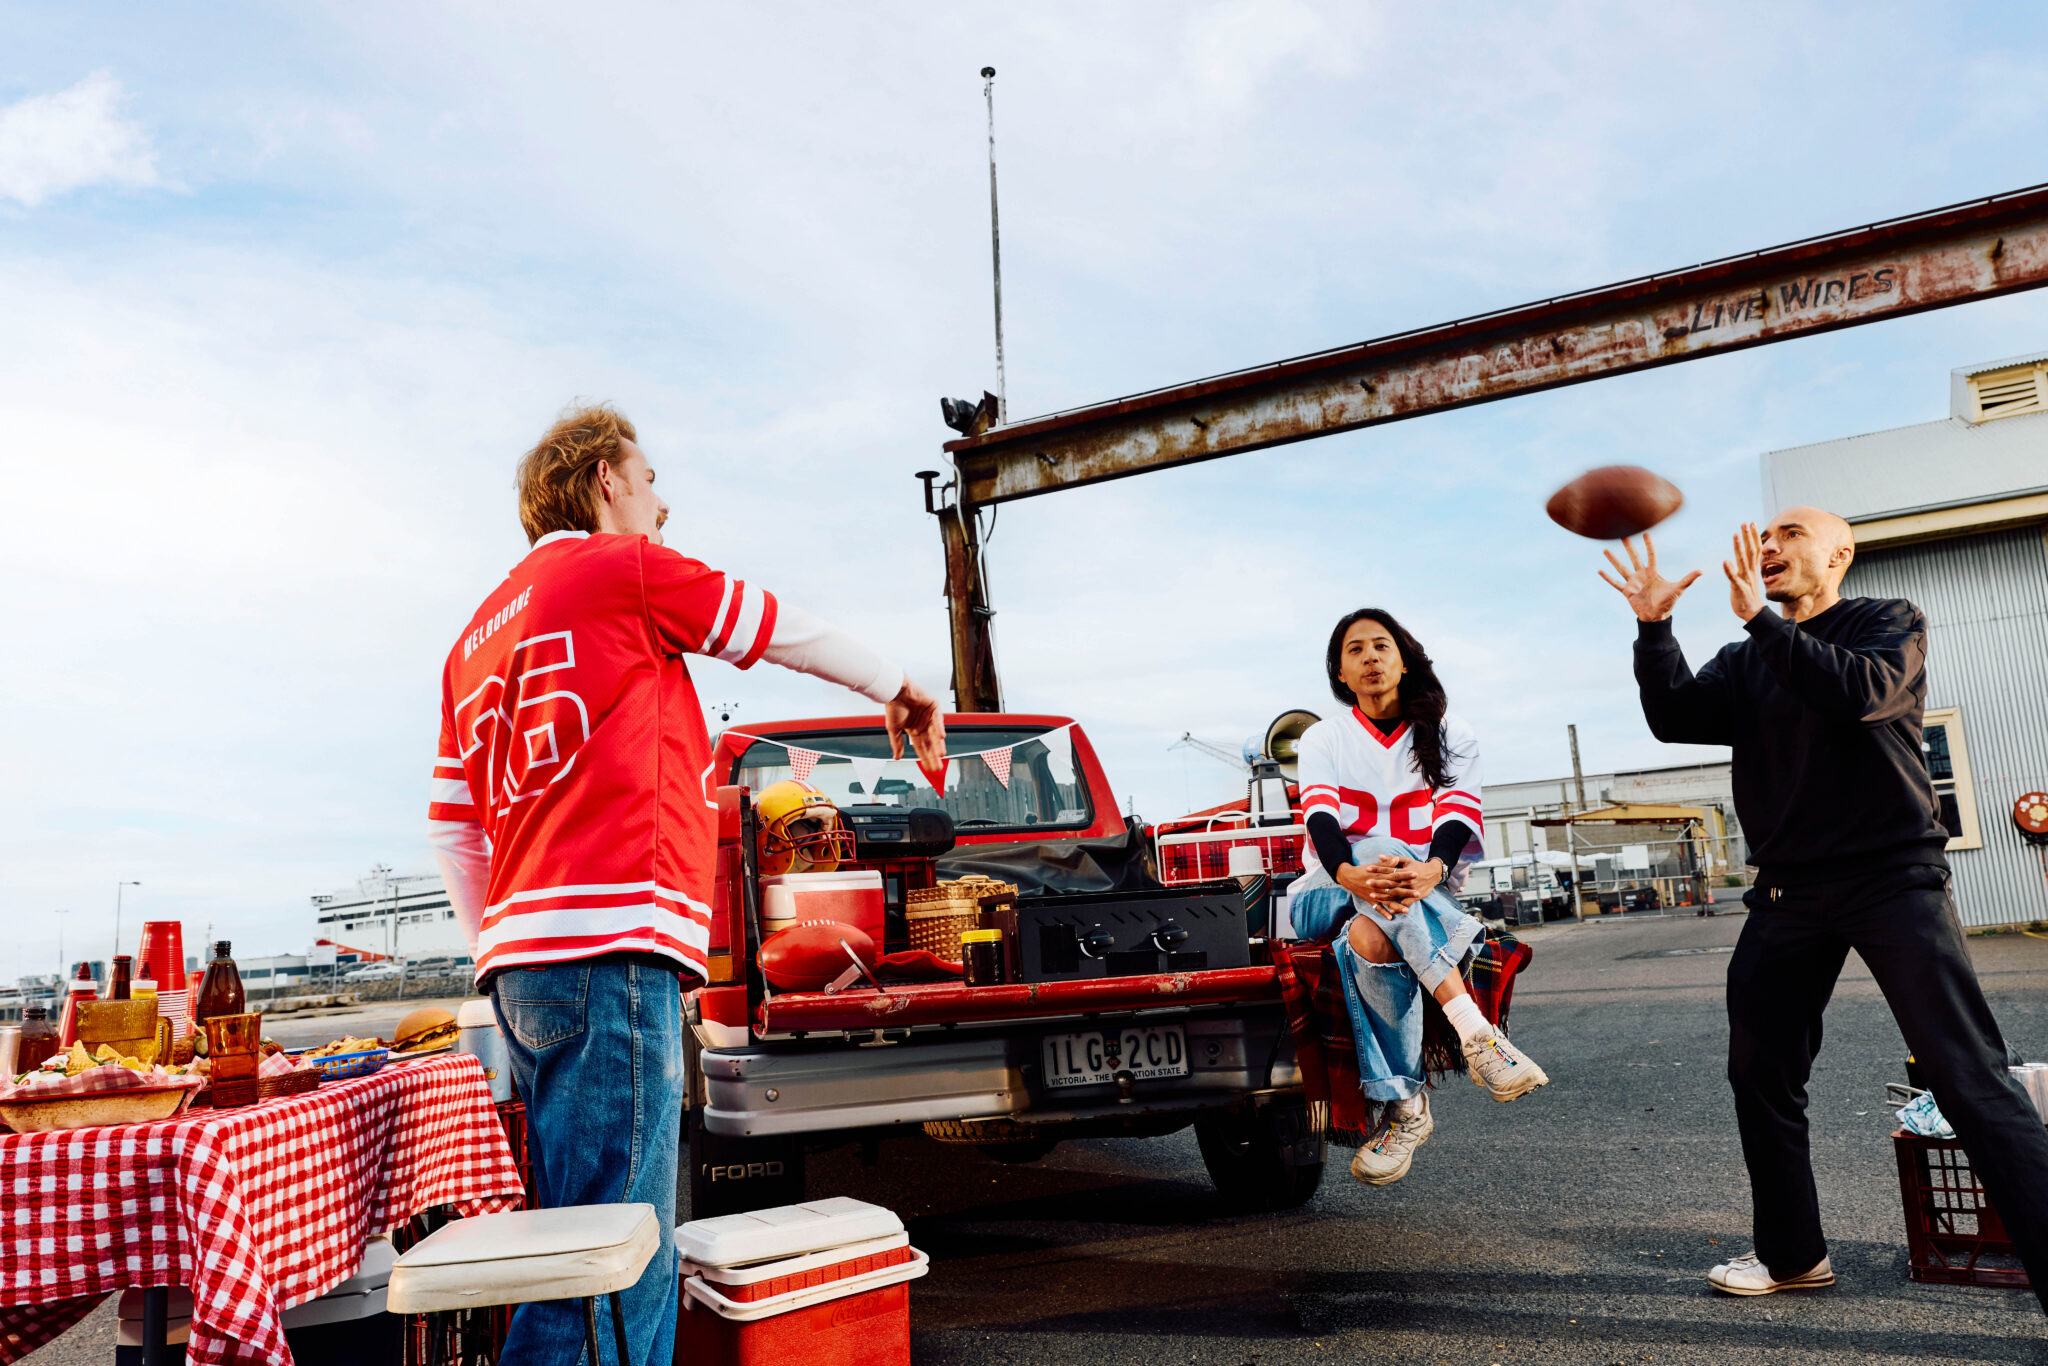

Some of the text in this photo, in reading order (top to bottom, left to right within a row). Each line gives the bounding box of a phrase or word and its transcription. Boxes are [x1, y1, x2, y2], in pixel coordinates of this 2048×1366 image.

[1690, 293, 1765, 334] LIVE
[1779, 268, 1894, 313] WIRES
[463, 584, 533, 662] MELBOURNE
[1051, 1075, 1087, 1086] VICTORIA
[1095, 1073, 1110, 1082] THE
[1158, 1067, 1182, 1076] STATE
[711, 1161, 784, 1182] FORD
